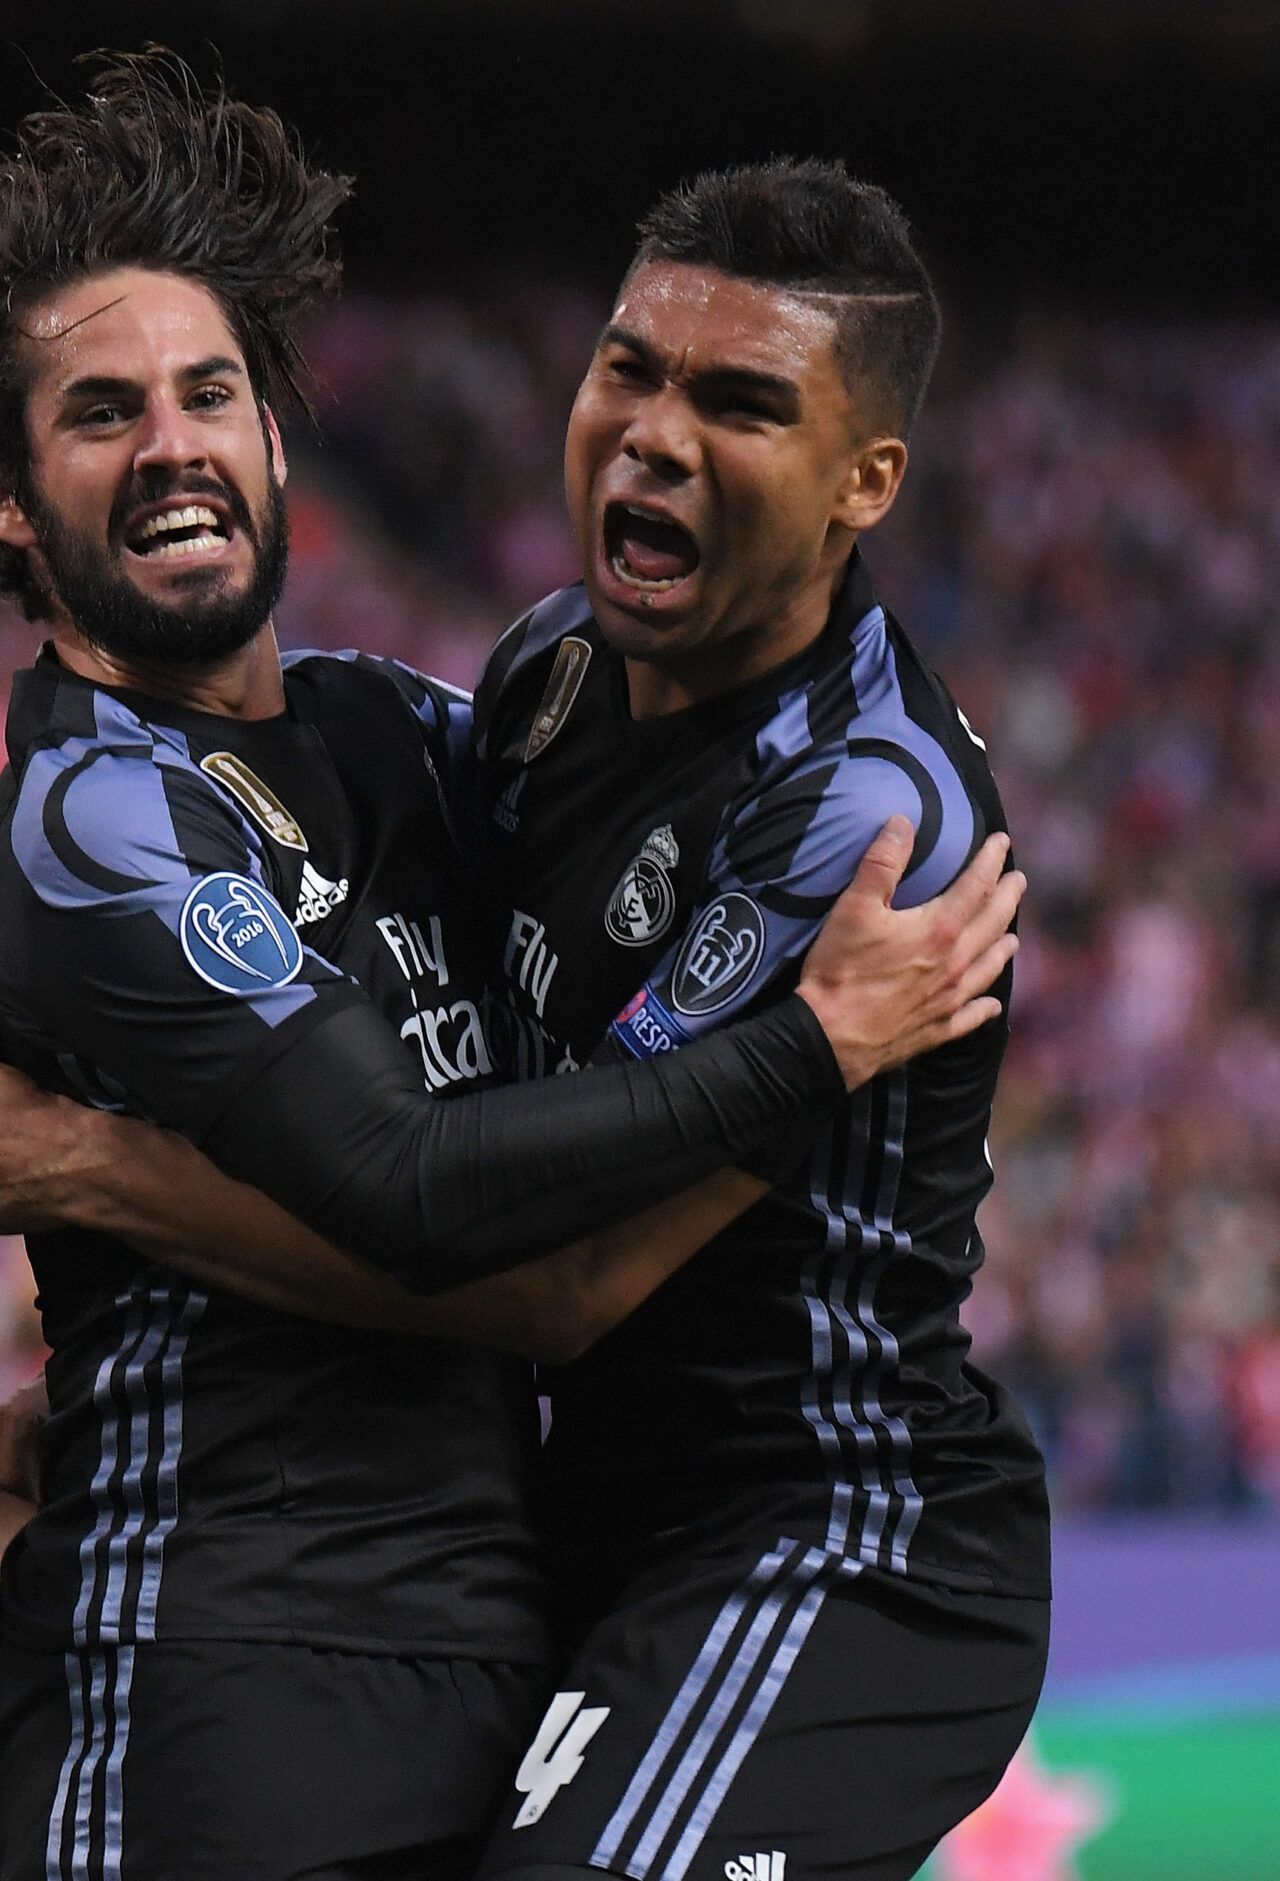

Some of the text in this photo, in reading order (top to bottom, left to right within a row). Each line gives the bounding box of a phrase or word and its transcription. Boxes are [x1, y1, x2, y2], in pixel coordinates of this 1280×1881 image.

[231, 920, 264, 948] 2016
[375, 912, 449, 986] Fly
[504, 908, 559, 1019] Fly
[629, 1007, 680, 1053] RESP
